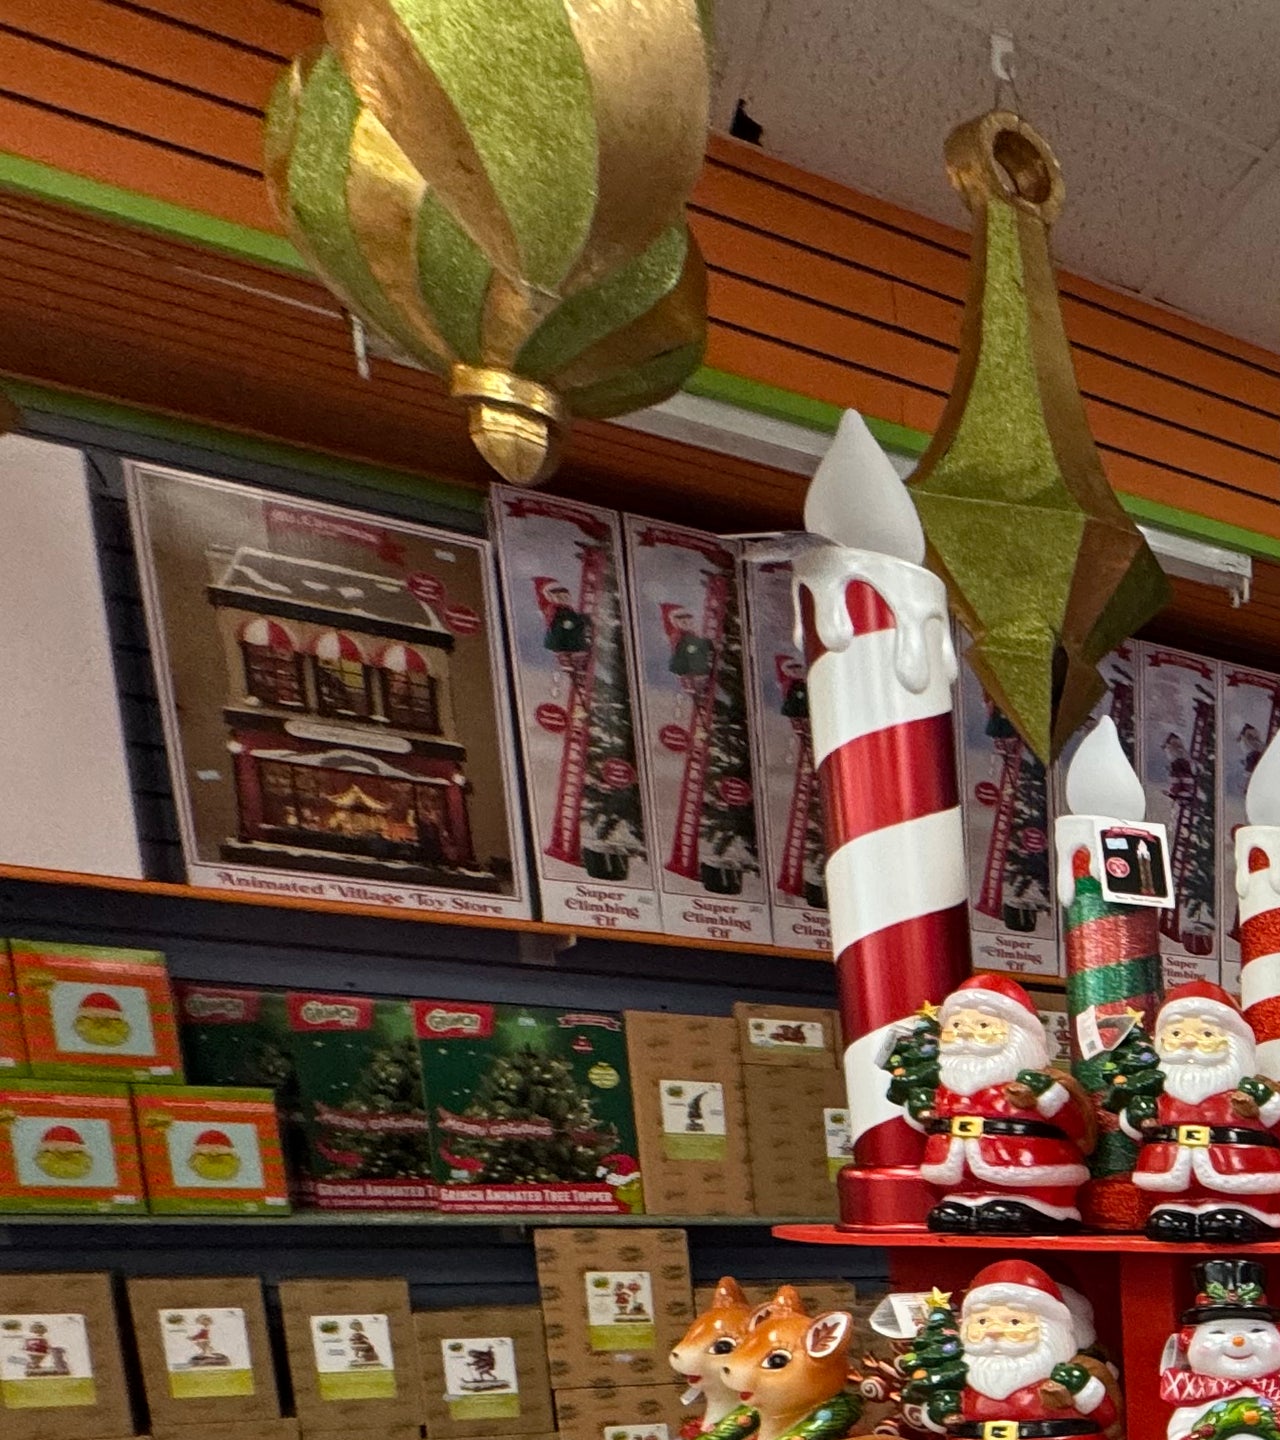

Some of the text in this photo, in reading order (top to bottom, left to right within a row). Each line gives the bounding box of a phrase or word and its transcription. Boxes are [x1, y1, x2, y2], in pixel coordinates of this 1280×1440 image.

[216, 871, 504, 915] Animated Village Toy Store
[576, 885, 625, 901] Super
[564, 899, 640, 920] Climbing
[692, 899, 738, 915] Super
[592, 915, 619, 927] Elf
[682, 911, 752, 932] Climbing
[802, 912, 831, 927] Sup
[707, 926, 731, 939] Elf
[792, 923, 831, 938] Clim
[995, 936, 1033, 949] Super
[1006, 961, 1024, 971] Elf
[1166, 956, 1199, 970] Super
[485, 1188, 542, 1202] ANIMATED
[543, 1188, 571, 1202] TREE
[572, 1189, 613, 1203] TOPPER
